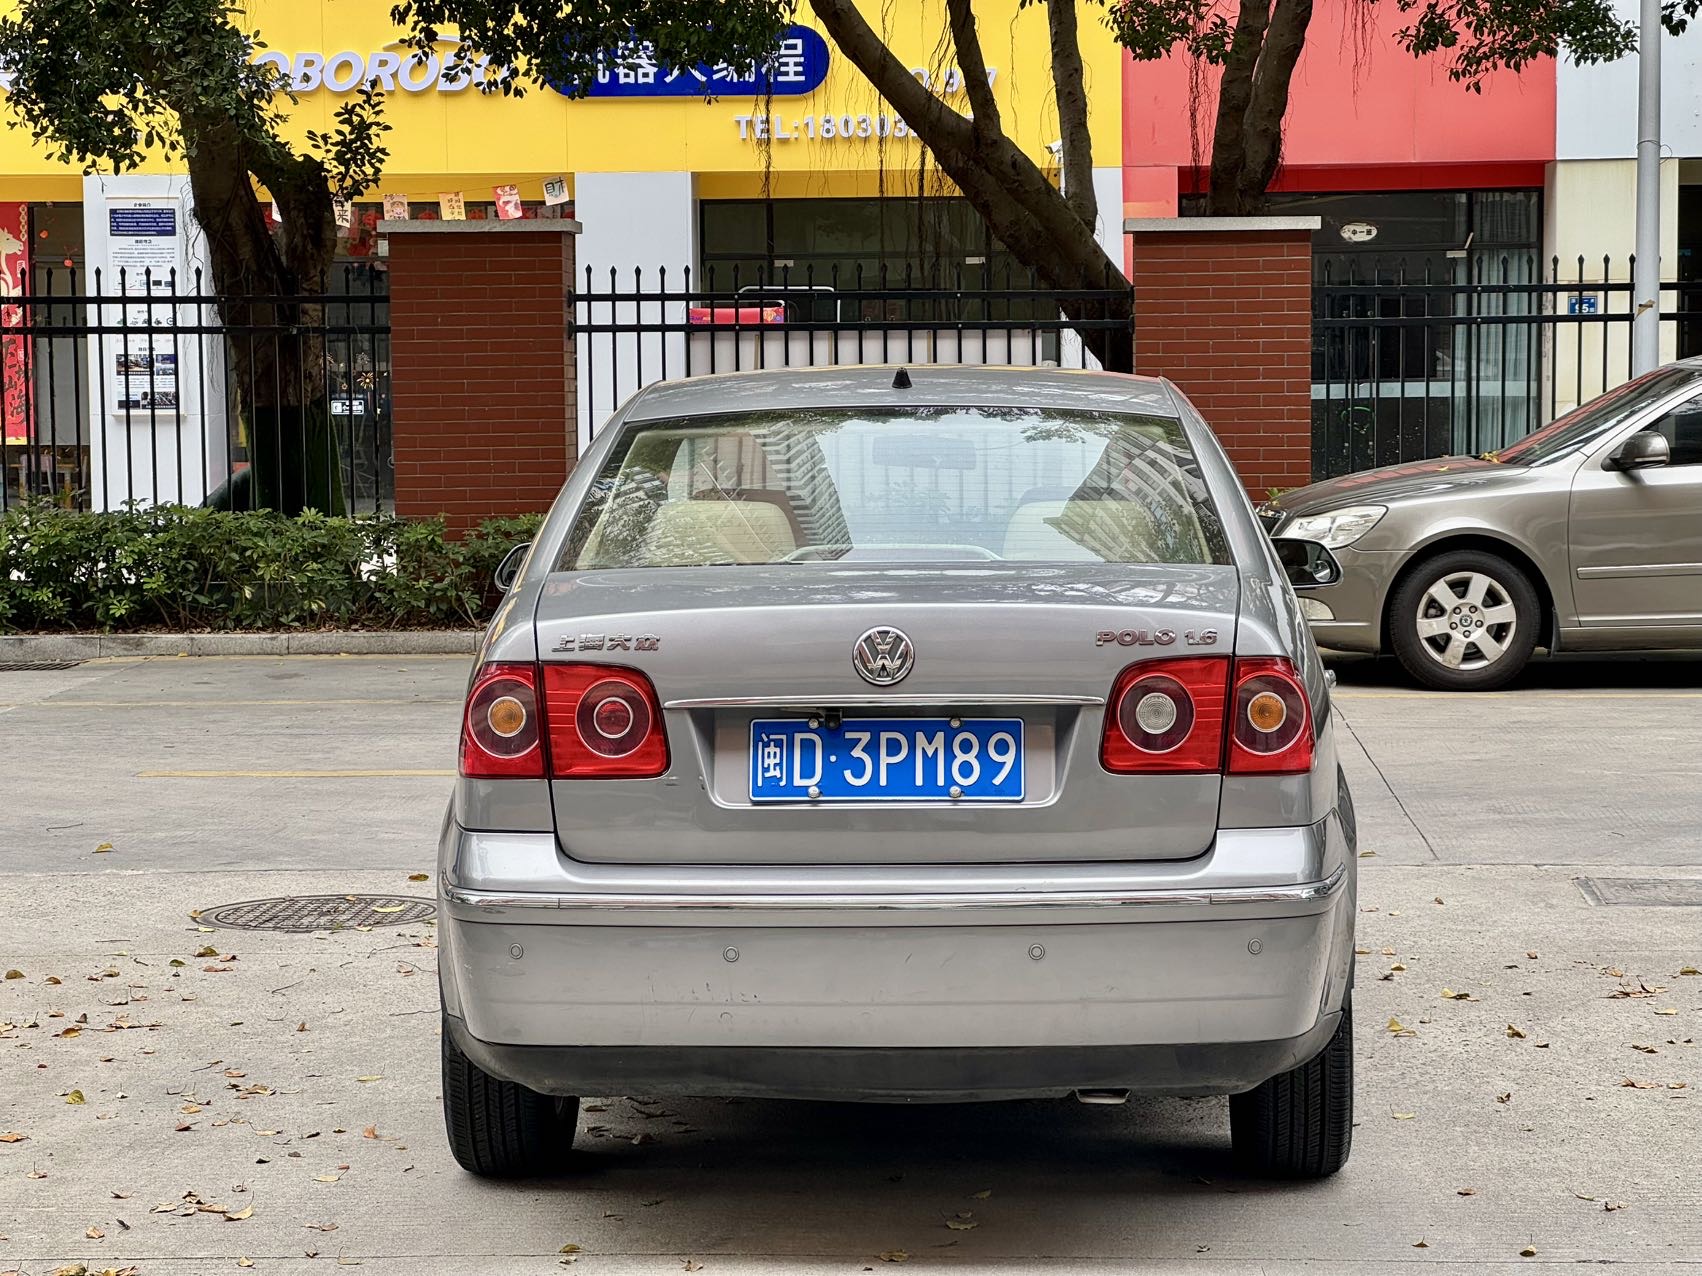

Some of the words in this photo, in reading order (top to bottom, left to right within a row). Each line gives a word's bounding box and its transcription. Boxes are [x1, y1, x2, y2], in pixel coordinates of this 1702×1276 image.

[551, 633, 660, 652] 上海大众
[1096, 628, 1177, 646] POLO
[1184, 628, 1218, 646] 1.6
